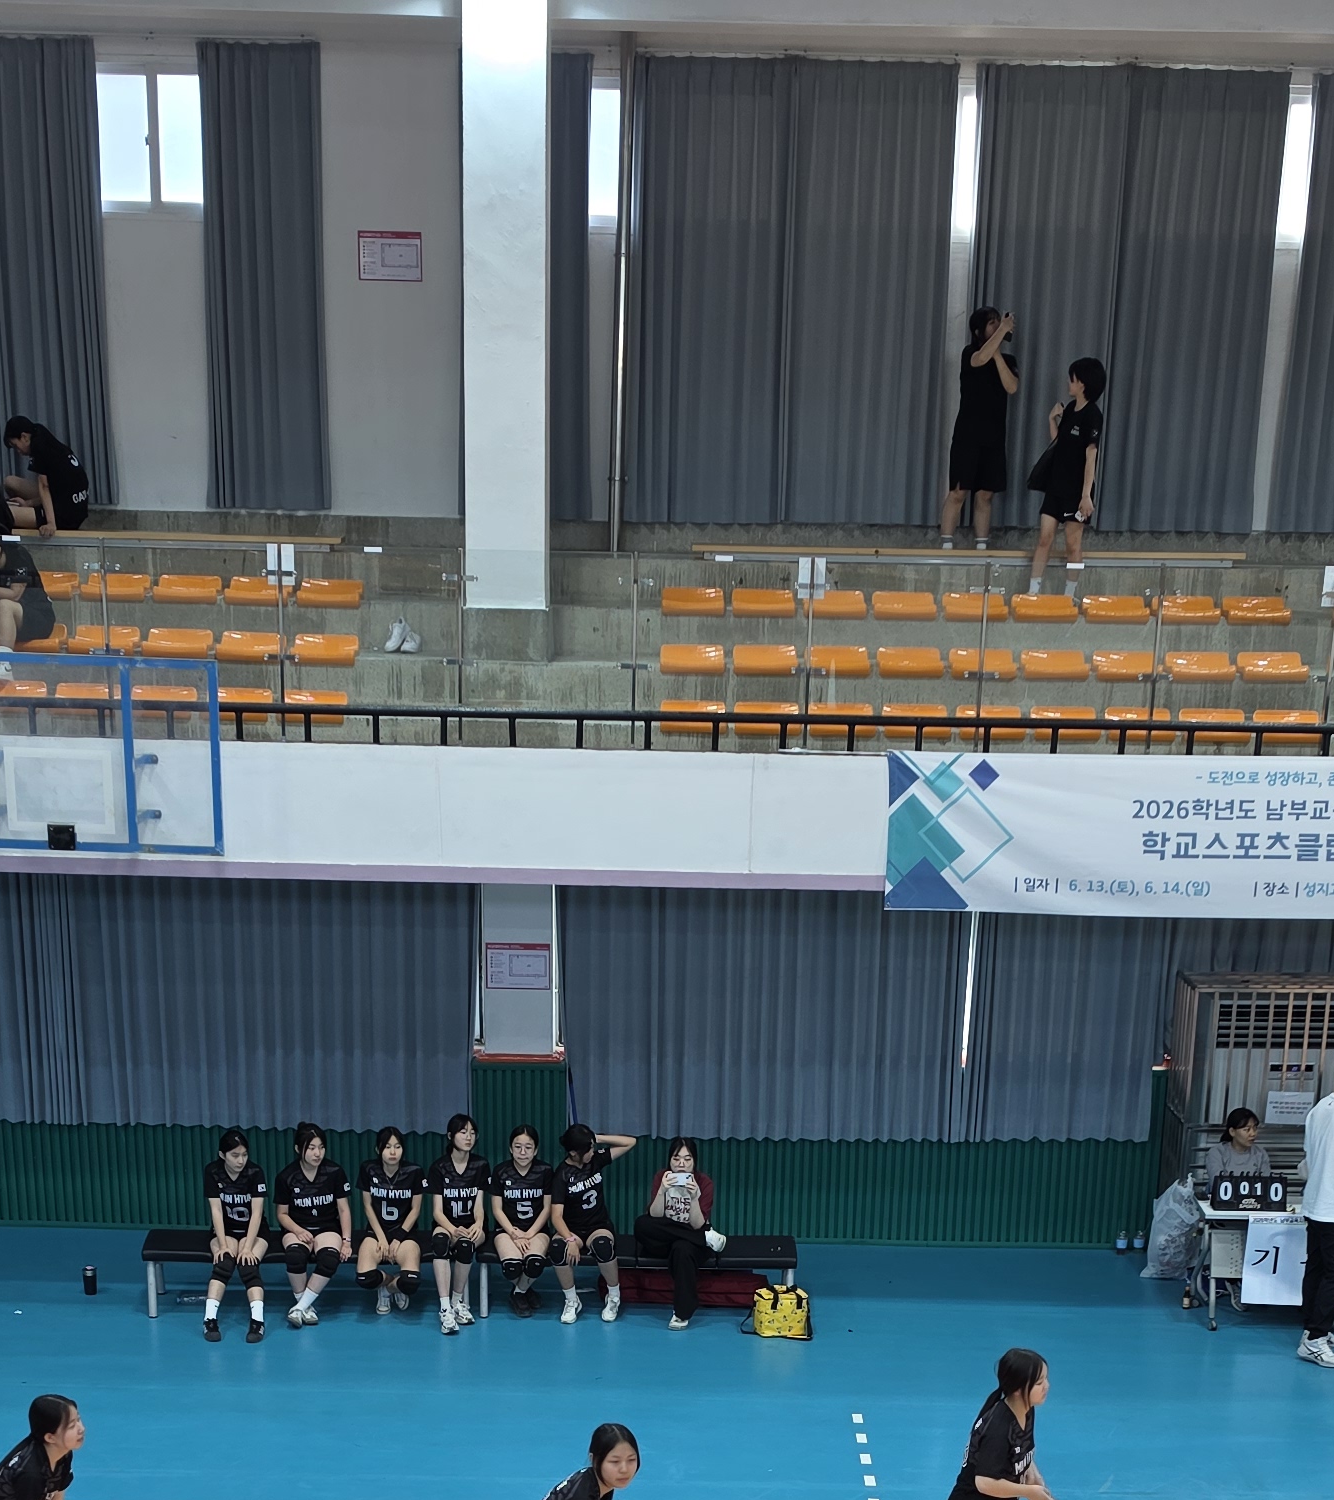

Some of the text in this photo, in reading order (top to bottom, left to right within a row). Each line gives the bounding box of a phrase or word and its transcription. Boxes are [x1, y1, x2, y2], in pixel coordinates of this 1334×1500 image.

[1206, 770, 1261, 786] 도전으로
[1264, 770, 1324, 788] 성장하고,
[1132, 797, 1258, 822] 2026학년도
[1023, 876, 1050, 894] 일자
[1262, 881, 1290, 898] 장소
[370, 1185, 412, 1199] MUN HYUN
[503, 1188, 522, 1199] MUN
[581, 1189, 599, 1210] 3
[1219, 1181, 1233, 1201] 0
[1239, 1181, 1250, 1195] 0
[1254, 1182, 1262, 1196] 1
[1269, 1182, 1283, 1202] 0
[381, 1200, 400, 1221] 6
[516, 1201, 534, 1220] 5
